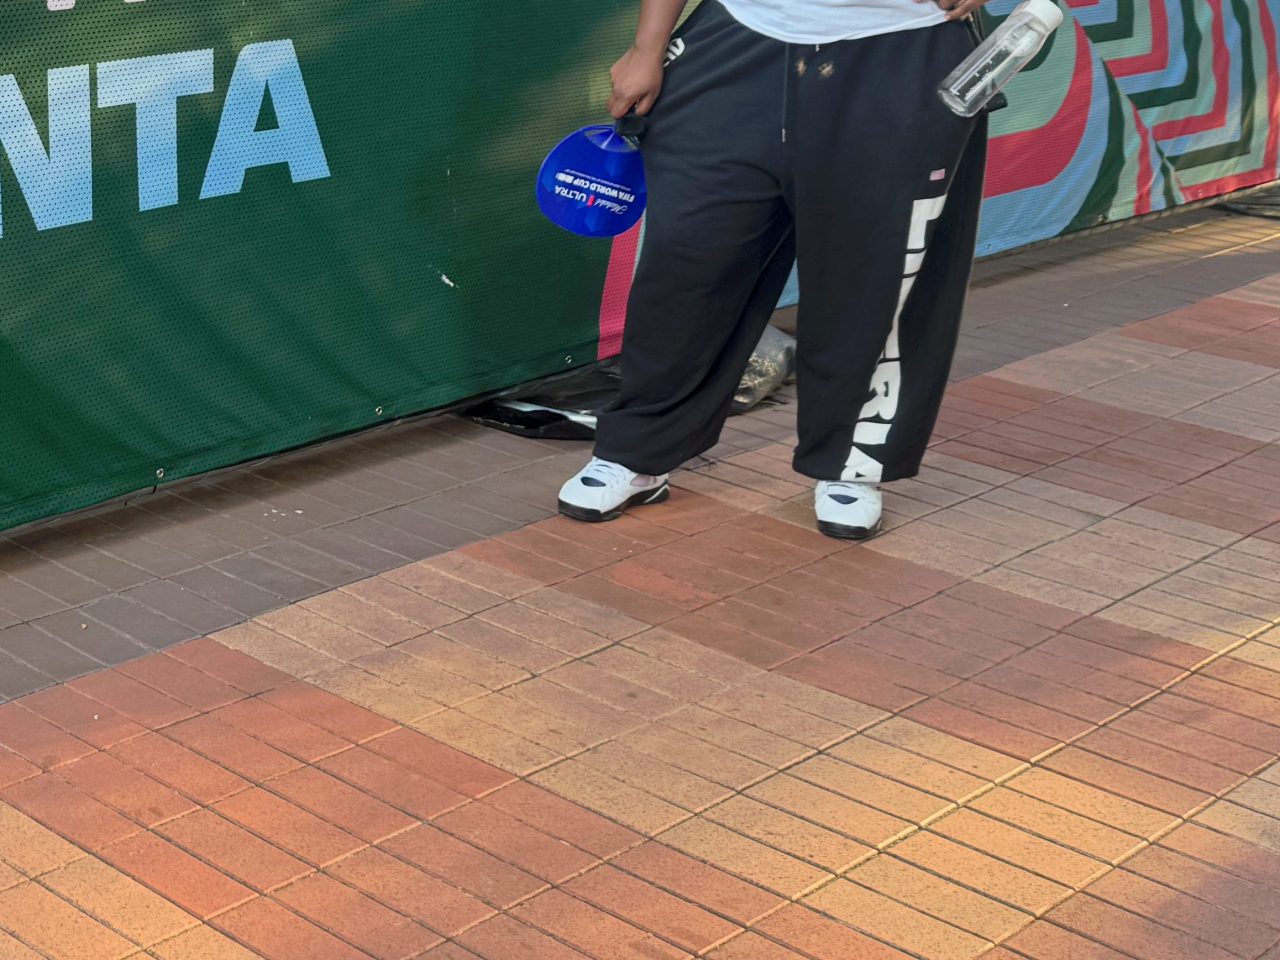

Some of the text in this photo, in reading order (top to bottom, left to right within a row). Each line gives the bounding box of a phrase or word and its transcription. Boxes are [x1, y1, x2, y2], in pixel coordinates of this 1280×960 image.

[573, 177, 590, 189] CUP
[589, 182, 619, 198] WORLD
[554, 185, 587, 202] ULTRA
[618, 191, 636, 203] FIFA
